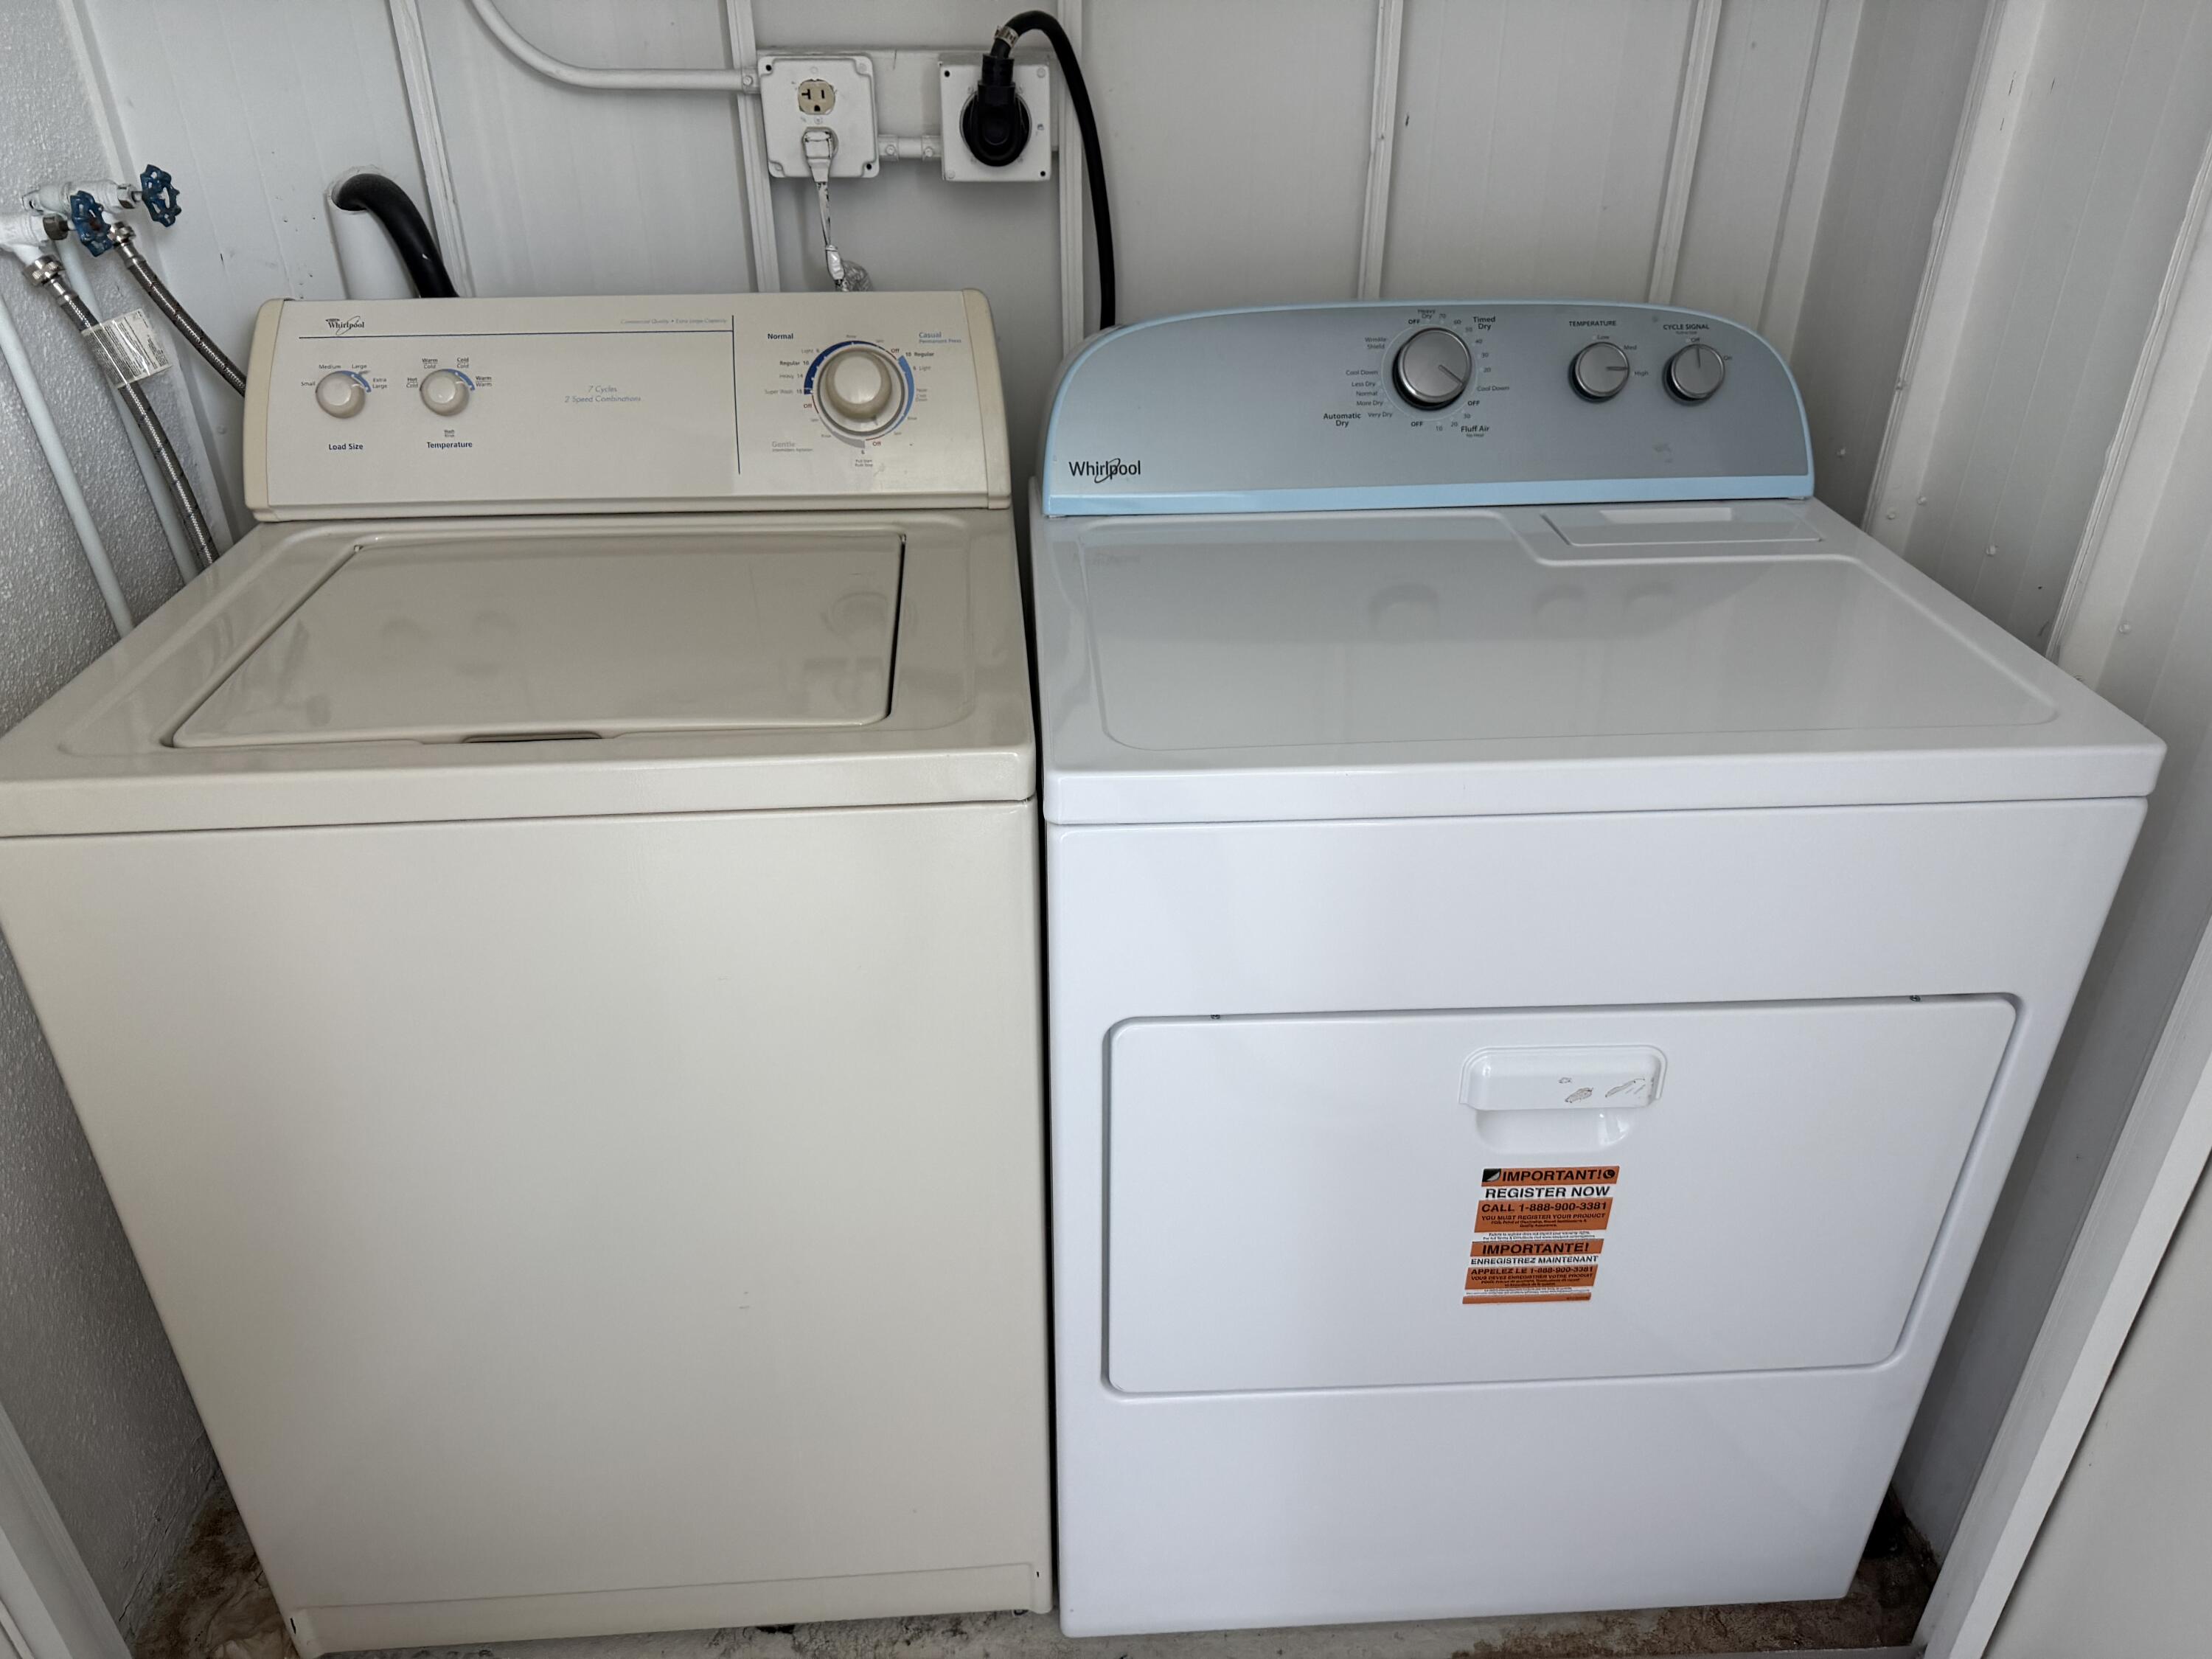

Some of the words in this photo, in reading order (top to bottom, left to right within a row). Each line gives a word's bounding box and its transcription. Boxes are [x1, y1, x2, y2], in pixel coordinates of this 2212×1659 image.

[1473, 316, 1496, 324] Timed
[326, 318, 365, 332] Whirlpool
[1478, 323, 1492, 331] Dry
[595, 386, 617, 394] Cycles
[572, 395, 593, 404] Speed
[595, 394, 641, 403] Combinations
[1323, 412, 1361, 420] Automatic
[1335, 420, 1349, 428] Dry
[349, 442, 364, 451] Size
[426, 441, 473, 450] Temperature
[1068, 458, 1141, 482] Whirlpool
[1502, 1169, 1601, 1182] IMPORTANT!
[1485, 1186, 1567, 1198] REGISTER
[1571, 1186, 1610, 1197] NOW
[1481, 1203, 1514, 1212] CALL
[1519, 1201, 1607, 1211] 1-888-900-3381
[1482, 1242, 1589, 1255] IMPORTANTE!
[1470, 1257, 1536, 1265] ENREGISTREZ
[1538, 1256, 1599, 1264] MAINTENANT
